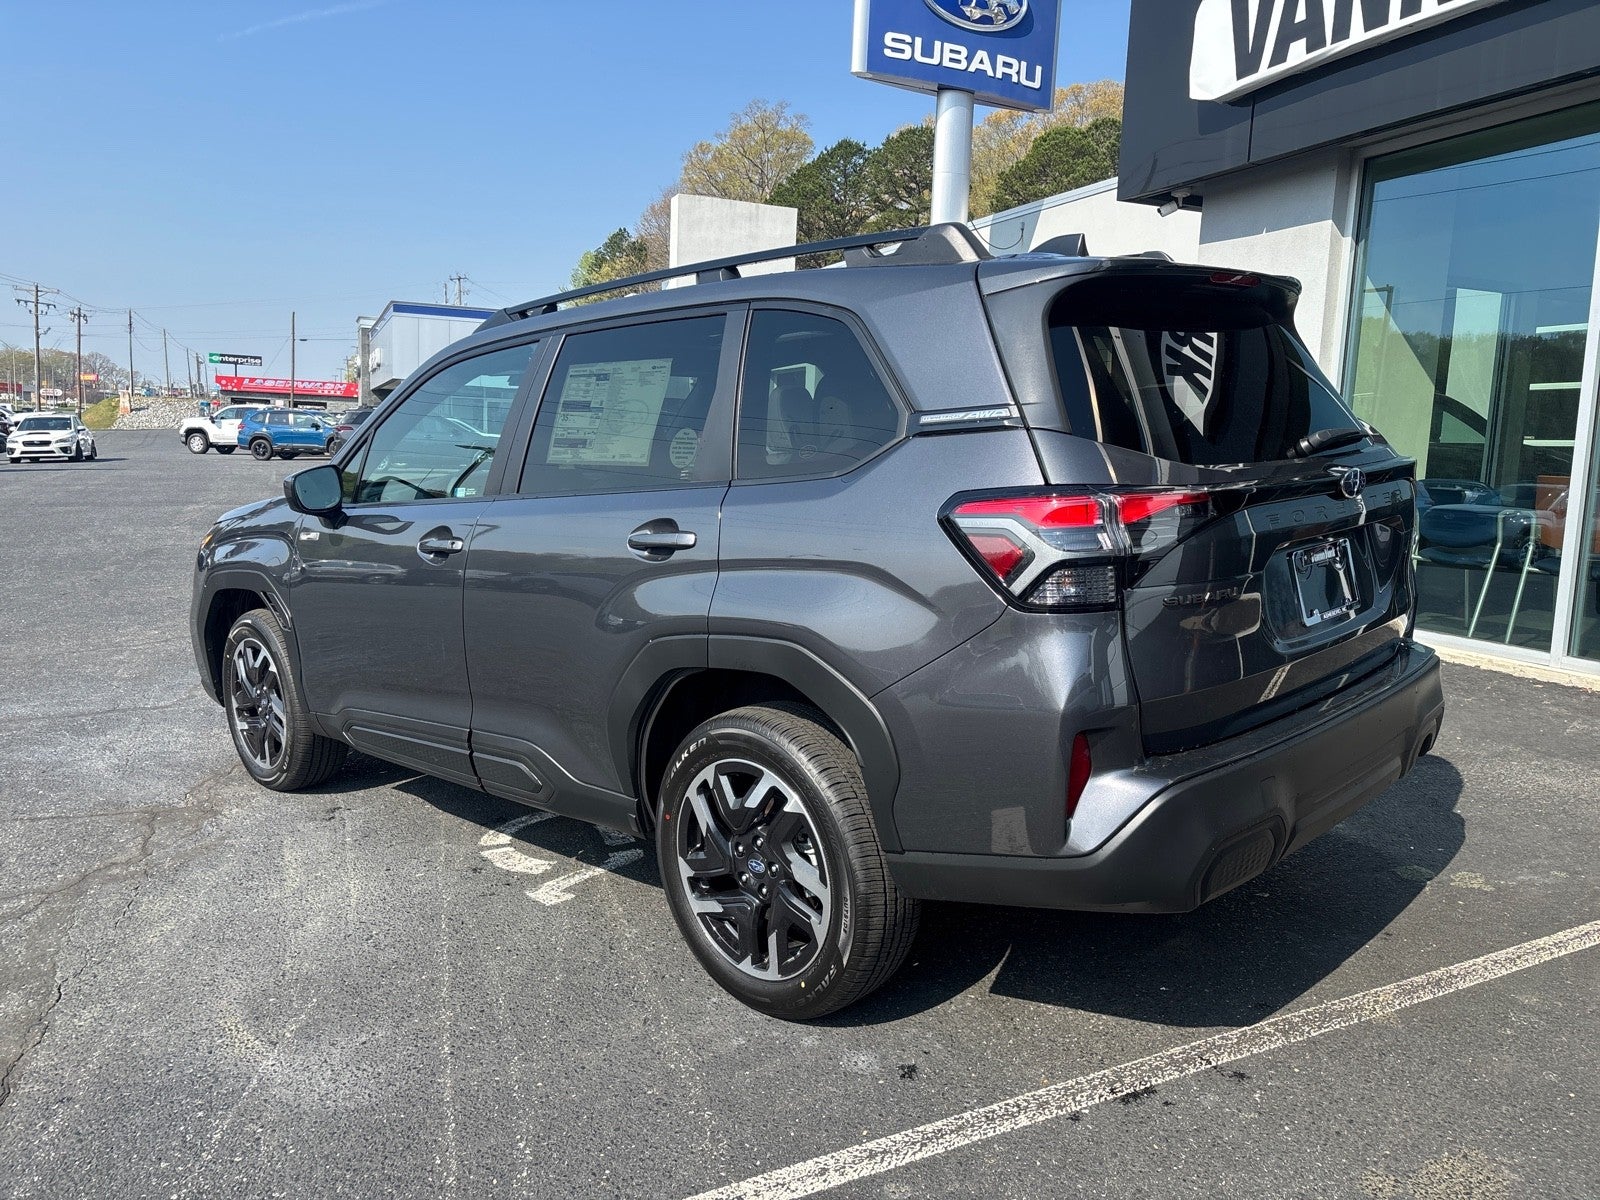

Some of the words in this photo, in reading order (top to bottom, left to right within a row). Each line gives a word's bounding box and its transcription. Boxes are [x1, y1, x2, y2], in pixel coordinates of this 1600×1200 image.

[883, 31, 1043, 90] SUBARU
[212, 354, 262, 364] enterprise
[1162, 586, 1239, 607] SUBARU
[842, 896, 850, 935] OUTSIDE
